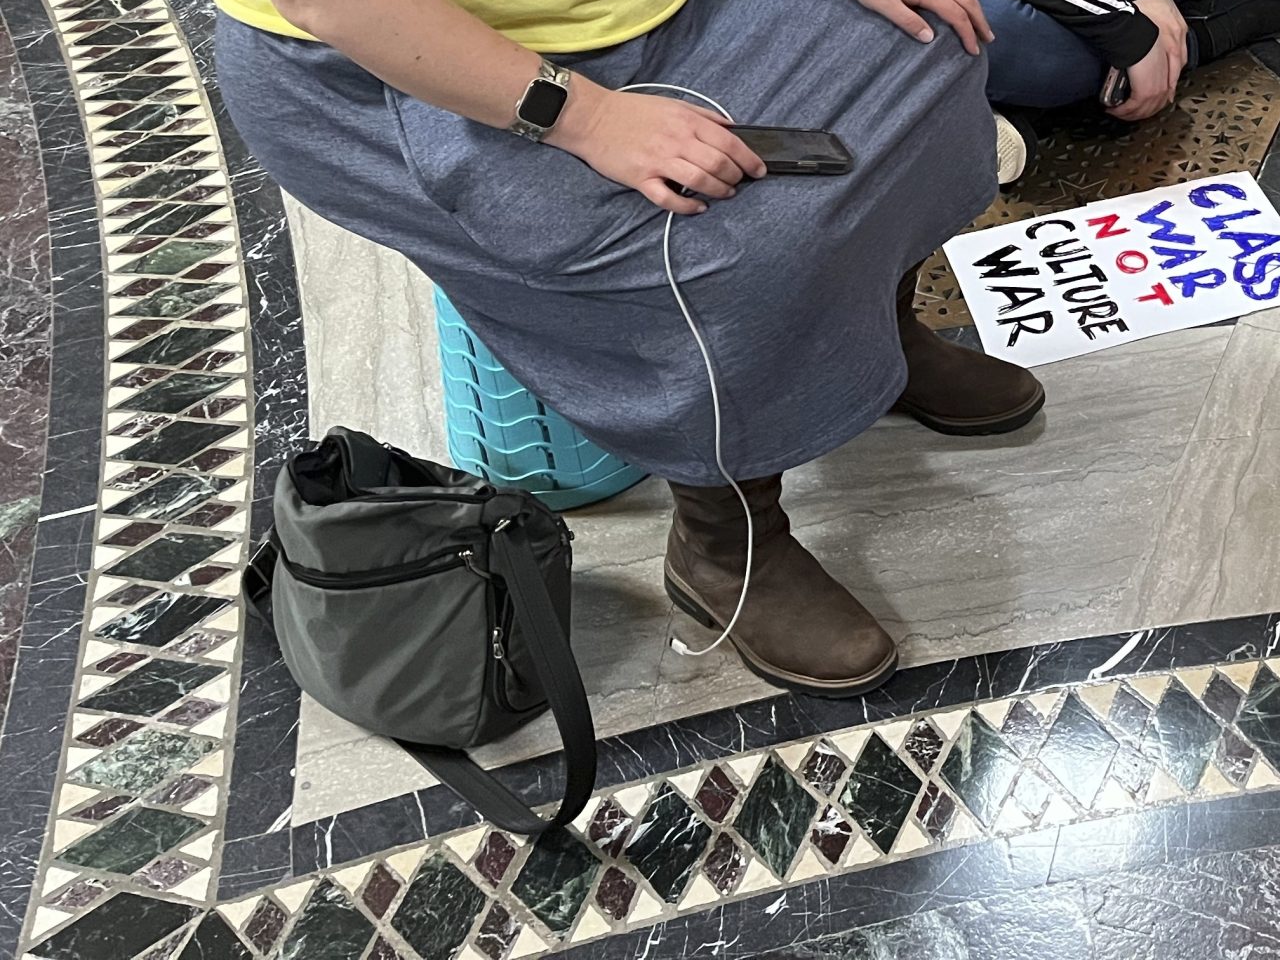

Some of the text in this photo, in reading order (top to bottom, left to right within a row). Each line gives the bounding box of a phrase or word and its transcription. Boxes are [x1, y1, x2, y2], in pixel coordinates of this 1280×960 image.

[971, 243, 1056, 349] WAR
[1025, 218, 1130, 341] CULTURE
[1085, 213, 1176, 306] NOT
[1135, 200, 1227, 299] WAR
